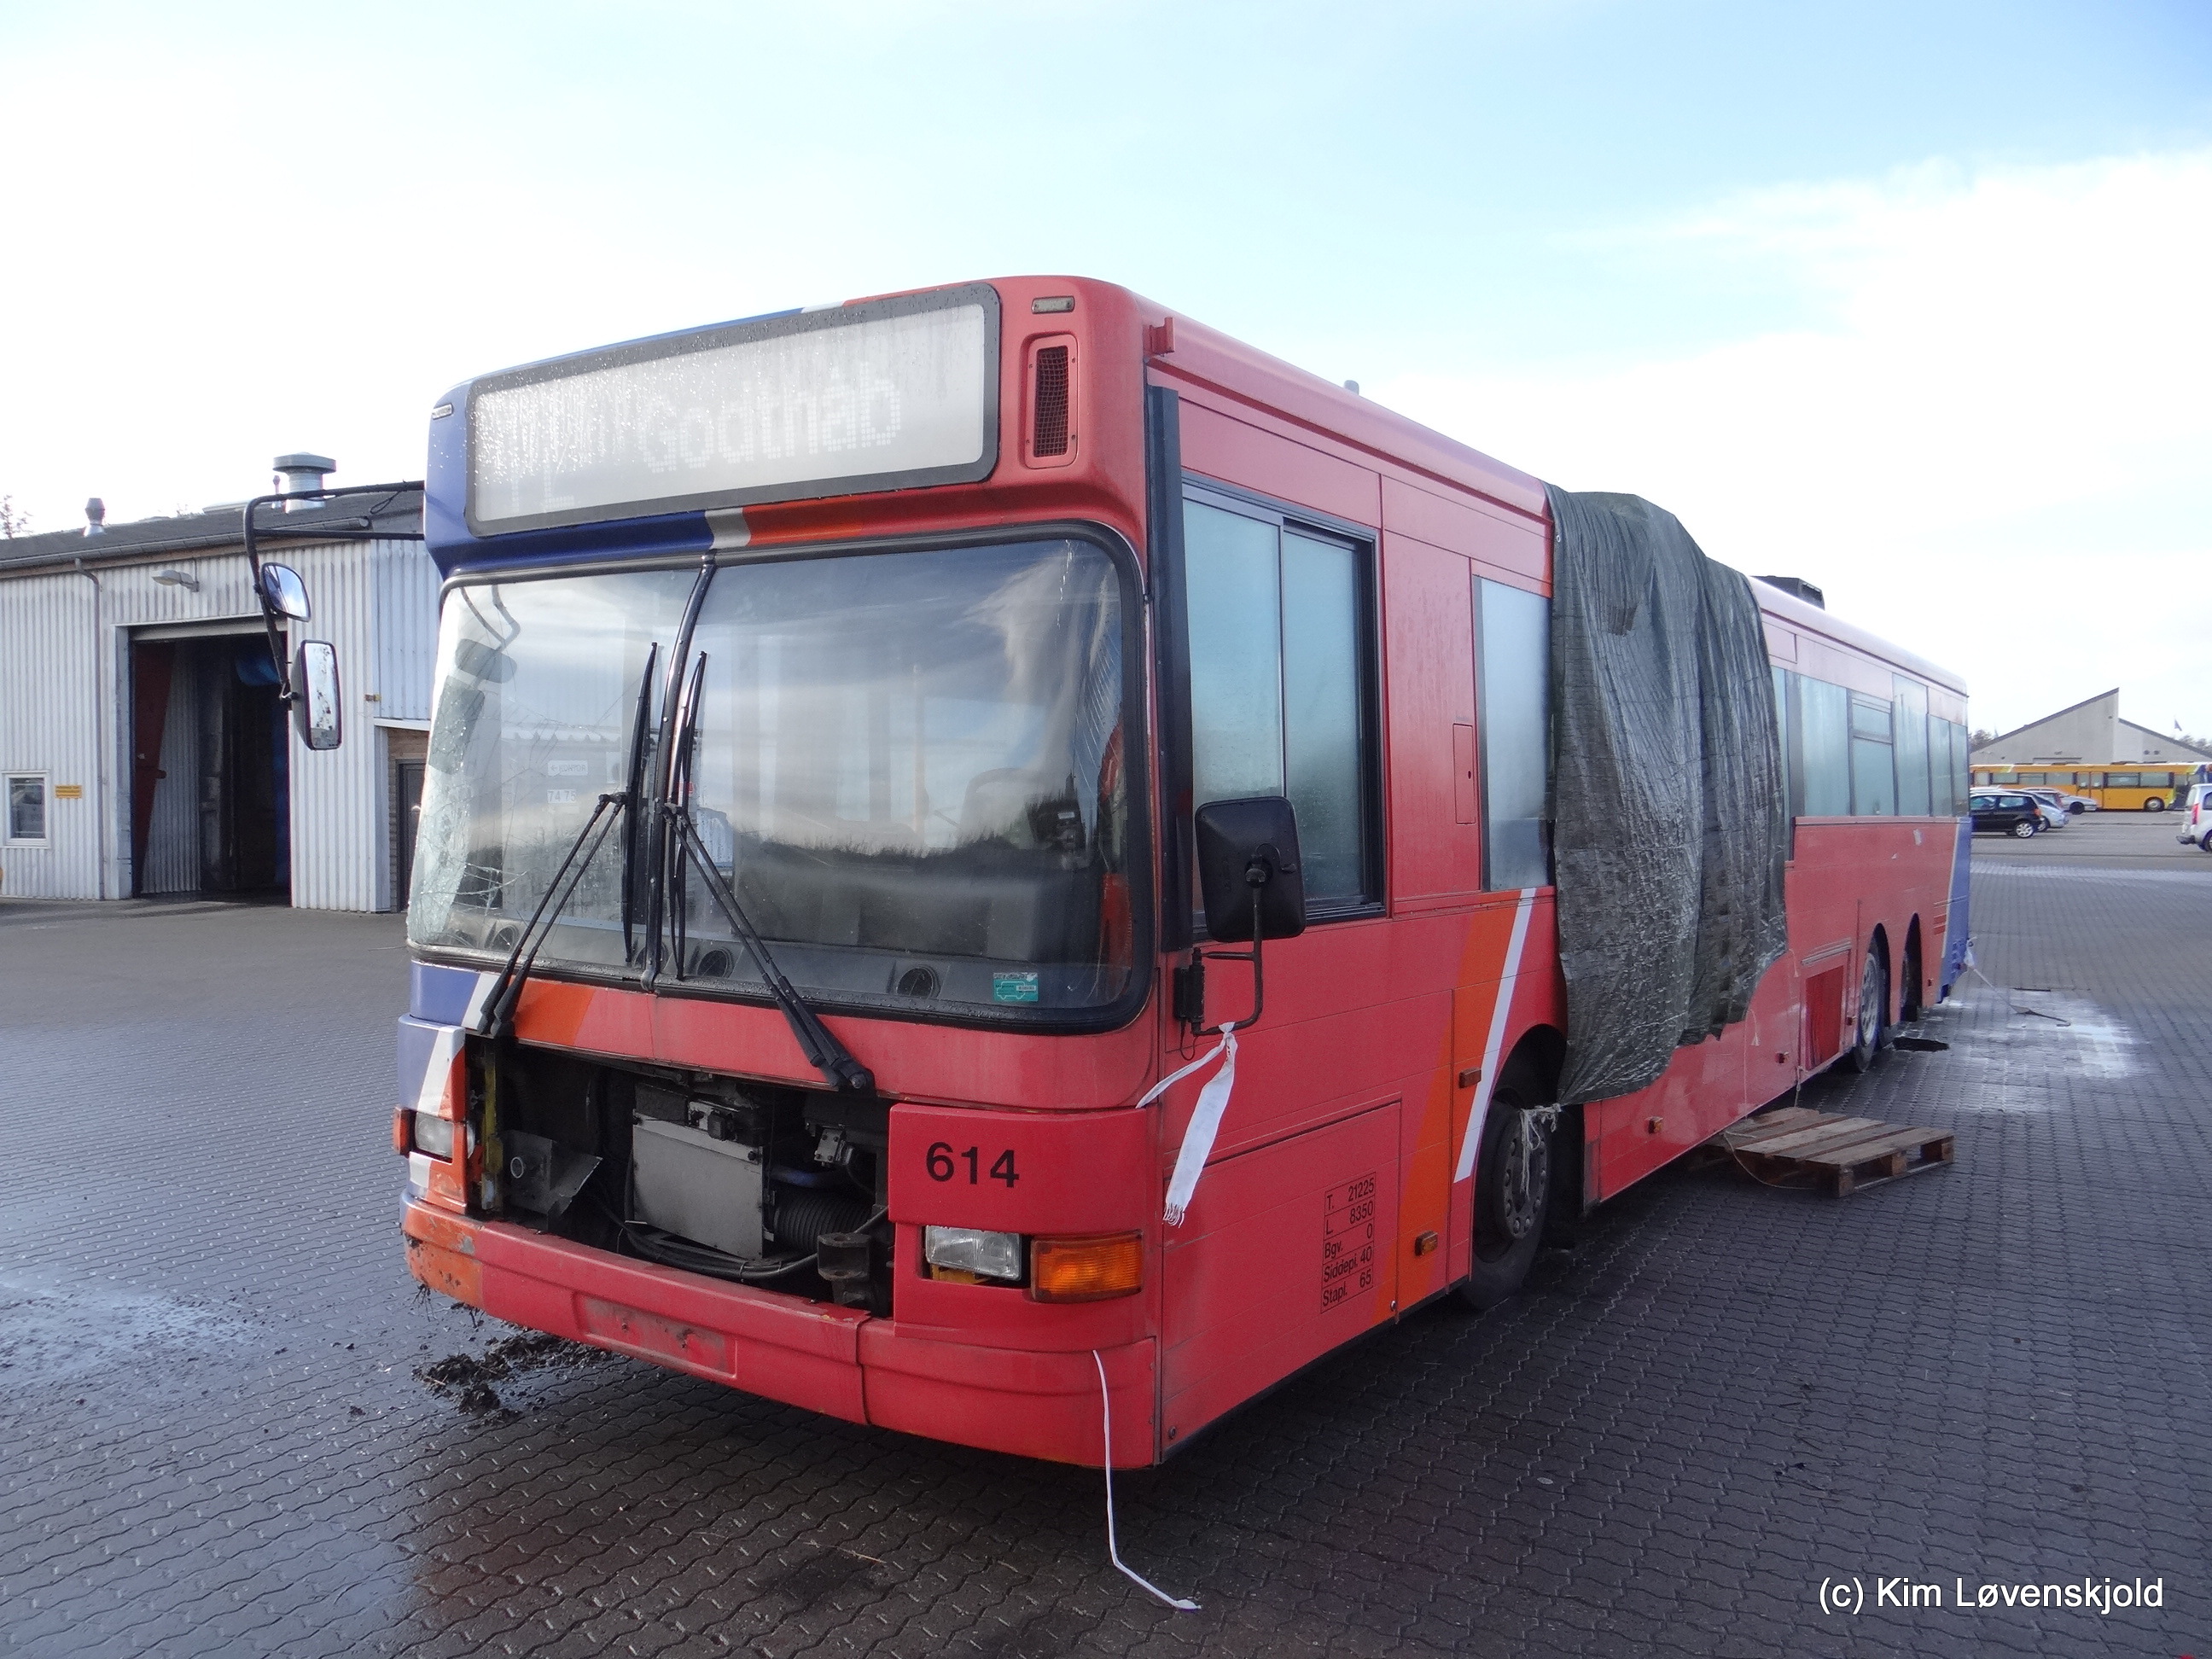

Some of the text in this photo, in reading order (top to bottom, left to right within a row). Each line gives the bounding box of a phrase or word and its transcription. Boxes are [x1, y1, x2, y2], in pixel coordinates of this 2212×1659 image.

[926, 1141, 1020, 1189] 614
[1348, 1177, 1374, 1202] 21225
[1349, 1201, 1373, 1225] 8350
[1324, 1223, 1373, 1260] Bgv. 0
[1360, 1246, 1372, 1263] 40
[1323, 1269, 1371, 1307] Stapl. 65
